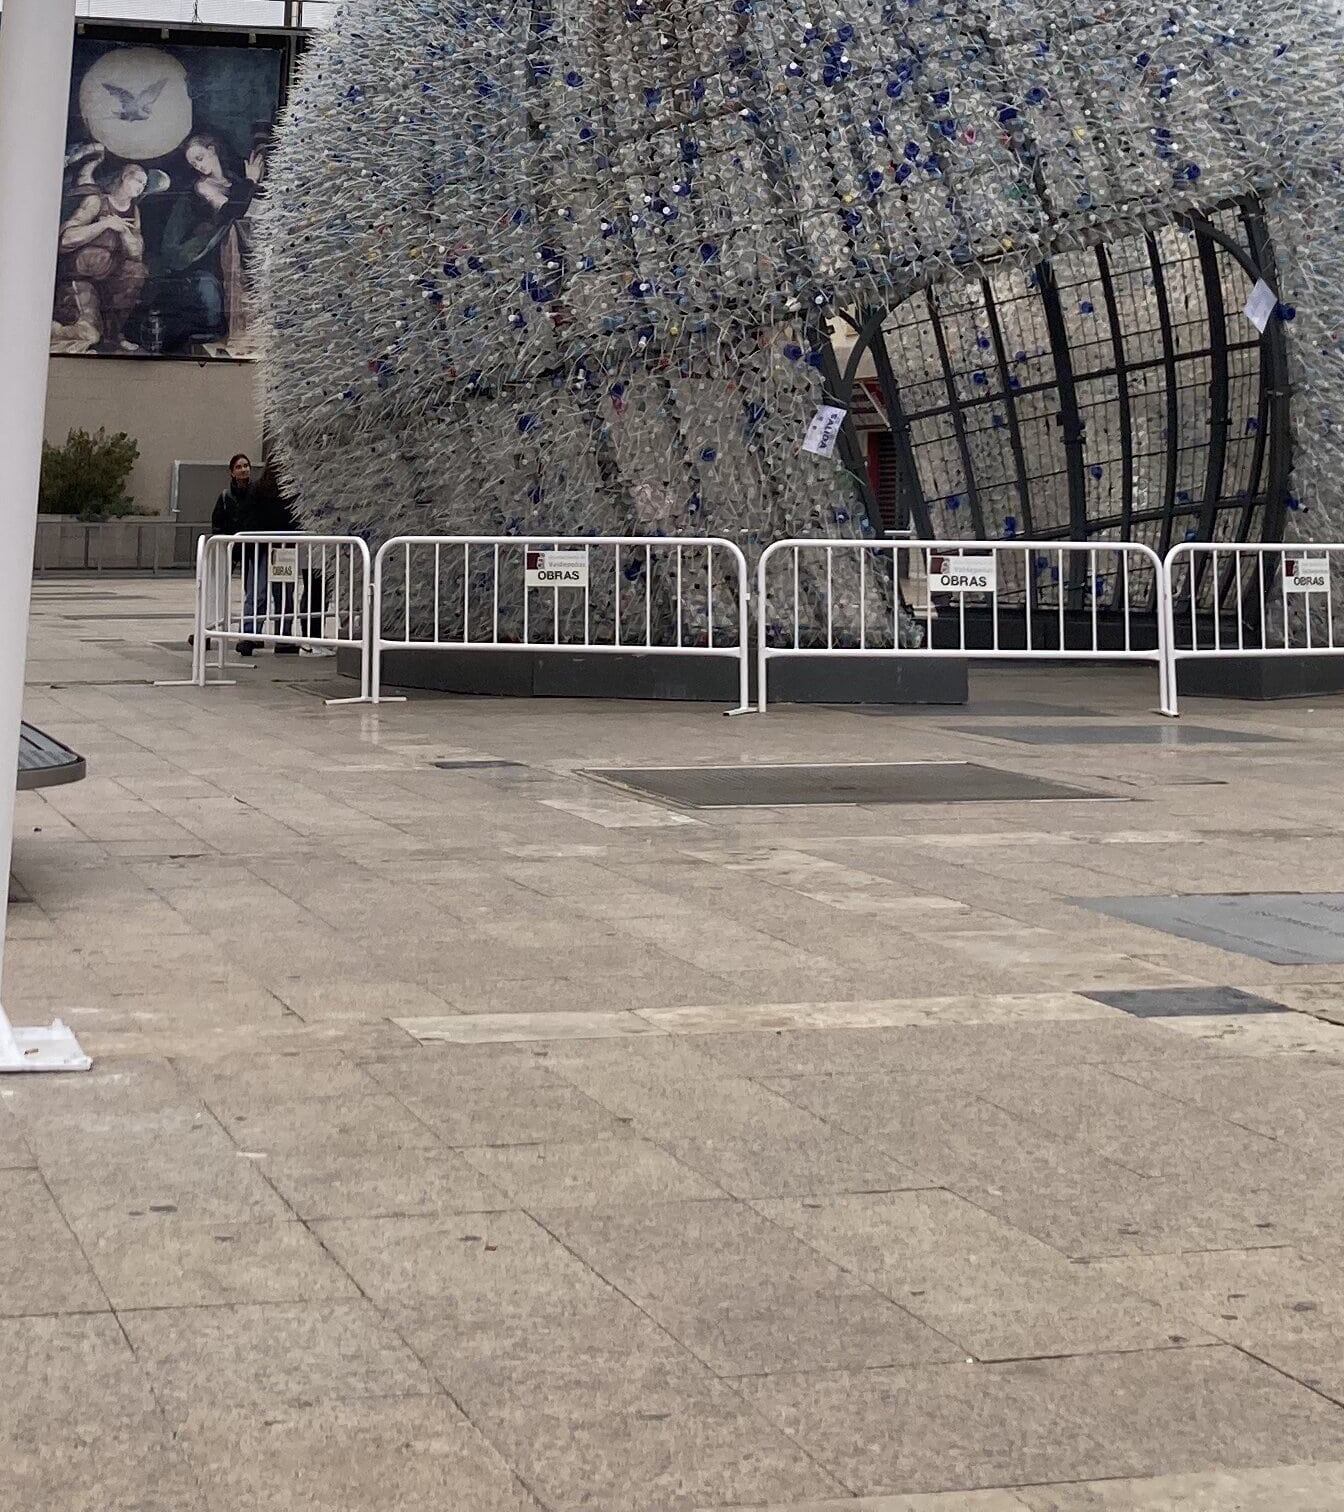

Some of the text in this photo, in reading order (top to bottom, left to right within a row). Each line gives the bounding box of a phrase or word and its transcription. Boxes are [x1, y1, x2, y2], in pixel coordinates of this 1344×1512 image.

[817, 413, 838, 449] SALIDA
[272, 565, 293, 576] OBRAS
[537, 570, 580, 581] OBRAS
[940, 574, 987, 587] OBRAS
[1293, 576, 1325, 586] OBRAS
